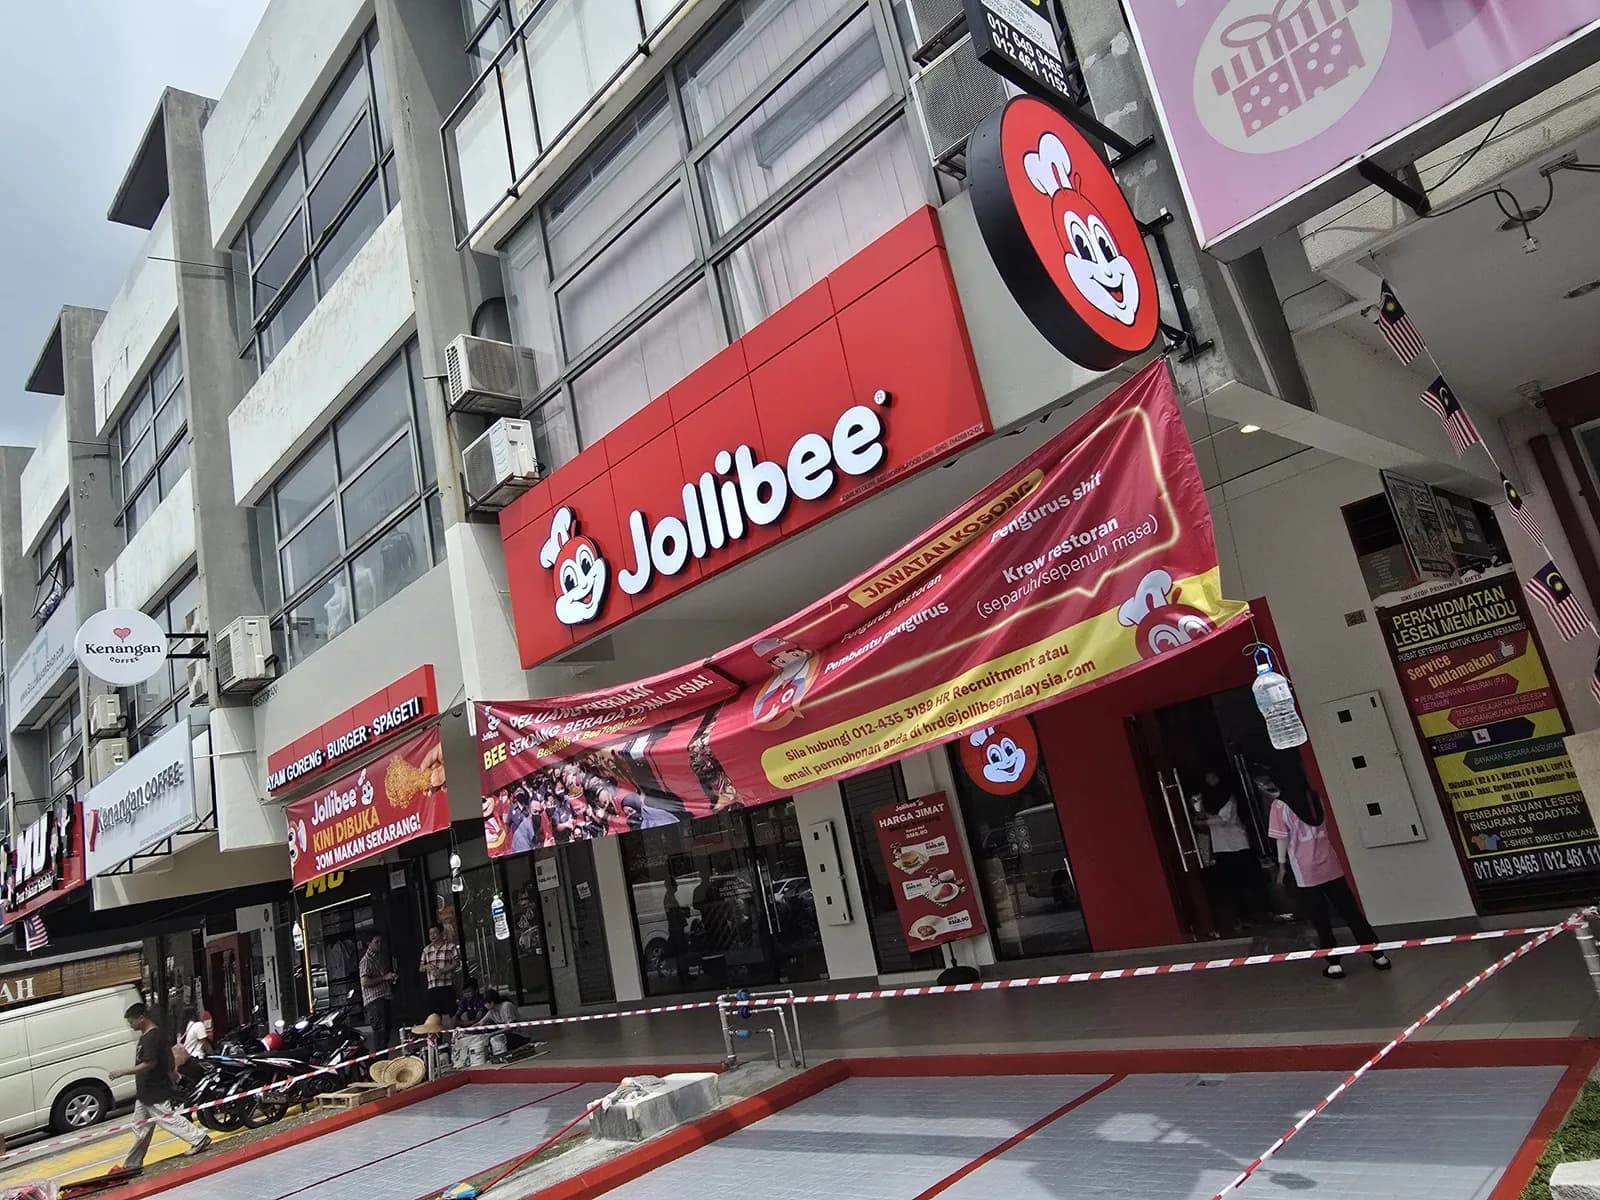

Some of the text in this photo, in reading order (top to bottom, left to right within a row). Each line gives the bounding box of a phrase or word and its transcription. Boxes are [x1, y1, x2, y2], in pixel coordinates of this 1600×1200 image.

[986, 12, 1009, 39] 017
[1012, 31, 1035, 57] 649
[1035, 48, 1064, 79] 9465
[992, 31, 1070, 97] 012 461 1152
[618, 405, 883, 595] Jollibee
[990, 470, 1103, 544] Pengurus shif
[862, 479, 1034, 600] JAWATAN KOSONG
[1002, 517, 1119, 584] Krew restoran
[976, 513, 1159, 619] (separuh/sepenuh masa)
[841, 573, 942, 644] Pengurus restoran
[1391, 585, 1506, 630] PERKHIDMATAN
[1391, 599, 1518, 647] LESEN MEMANDU
[85, 643, 161, 657] Kenangan
[109, 656, 140, 664] COFFEE
[824, 602, 950, 674] Pembantu pengurus
[1418, 642, 1449, 658] SETEMPAT
[1449, 638, 1472, 650] UNTUK
[1471, 630, 1494, 643] KELAS
[1493, 621, 1528, 637] MEMANDU
[1407, 654, 1452, 681] Service
[1428, 652, 1496, 689] Diutamakan
[483, 741, 508, 770] BEE
[562, 708, 626, 734] BERADA
[644, 674, 714, 711] MALAYSIA!
[782, 658, 1097, 785] email permohonan anda di hrd@jollibeemalaysia.com
[785, 642, 1071, 762] Sila hubungi 012-435 3189 HR Recruitment atau
[265, 696, 422, 792] AYAM GORENG BURGER SPAGETI
[571, 732, 582, 743] &
[1473, 752, 1504, 766] BAYARAN
[1503, 747, 1530, 760] SECARA
[144, 760, 183, 802] COFFEE
[311, 788, 357, 826] Jollibee
[312, 806, 381, 853] KINI DIBUKA
[878, 812, 915, 828] HARGA
[914, 802, 945, 818] JIMAT
[1463, 799, 1544, 822] PEMBAHARUAN
[1470, 806, 1581, 832] INSURAN & ROADTAX
[315, 812, 422, 871] JOM MAKAN SEKARANG!
[1500, 826, 1533, 838] CUSTOM
[1503, 835, 1534, 848] T-SHIRT
[1535, 831, 1566, 844] DIRECT
[1473, 860, 1493, 880] 017
[1493, 856, 1513, 877] 649
[1513, 853, 1540, 875] 9465
[1544, 849, 1566, 871] 012
[1566, 846, 1587, 868] 461
[0, 976, 35, 1001] AH
